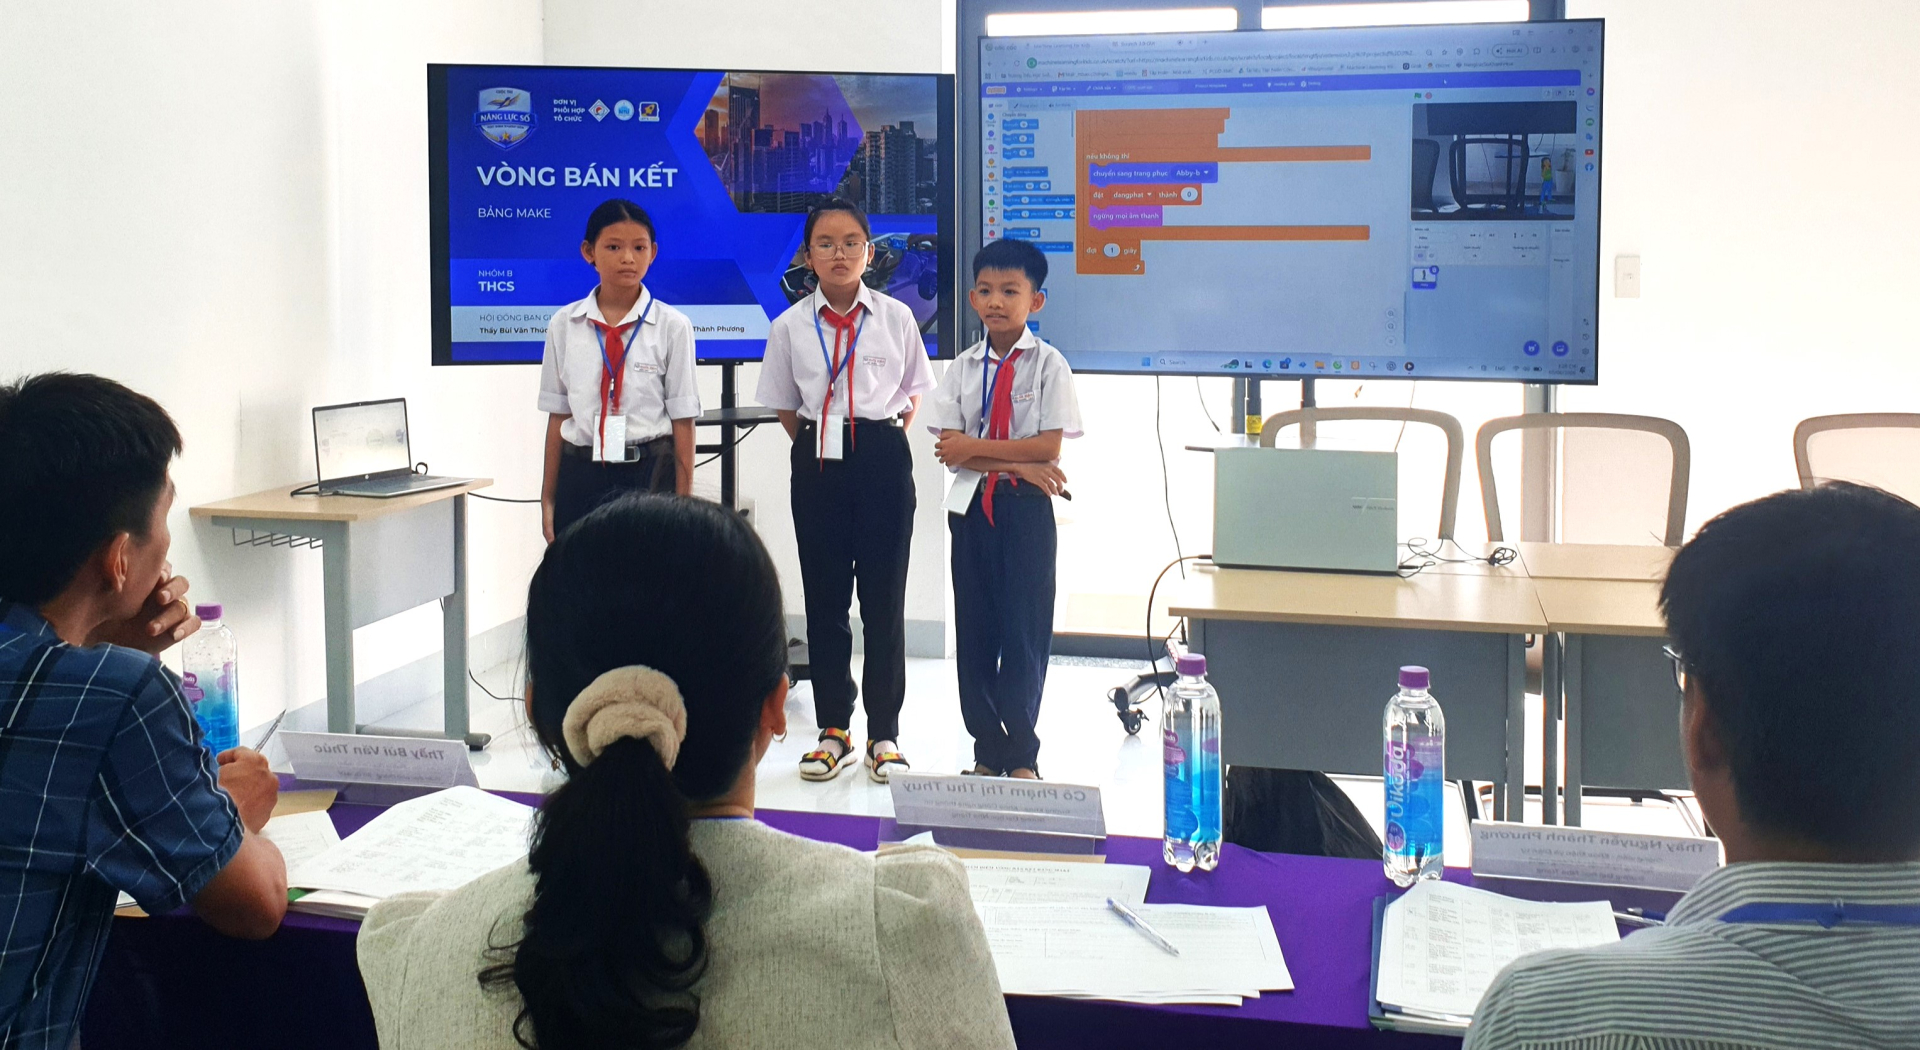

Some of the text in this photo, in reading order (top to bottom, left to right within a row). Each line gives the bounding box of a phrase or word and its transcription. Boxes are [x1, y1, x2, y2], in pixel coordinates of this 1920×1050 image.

[476, 161, 679, 188] VÒNG BÁN KẾT
[1133, 170, 1151, 178] trang
[1152, 169, 1168, 178] phục
[1176, 169, 1201, 177] Abby-b
[478, 205, 552, 218] BẢNG MAKE
[478, 269, 505, 277] NHÓM
[478, 281, 515, 292] THCS
